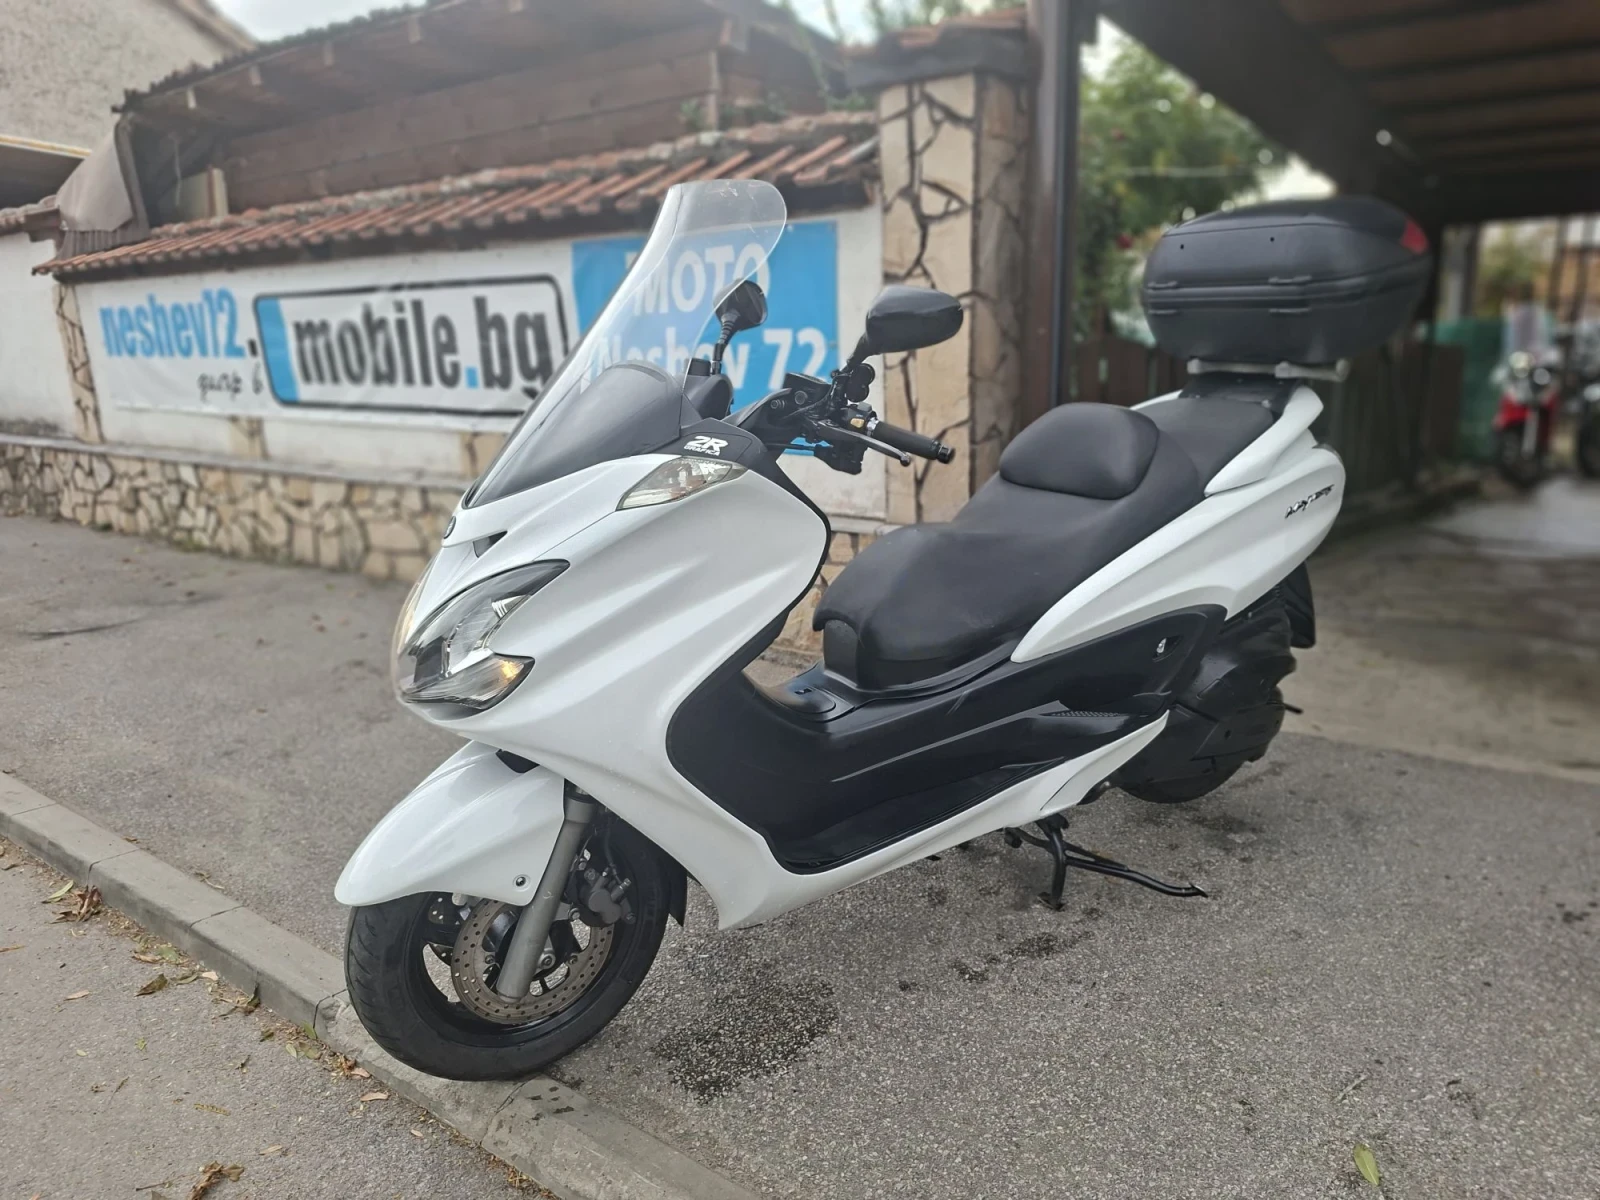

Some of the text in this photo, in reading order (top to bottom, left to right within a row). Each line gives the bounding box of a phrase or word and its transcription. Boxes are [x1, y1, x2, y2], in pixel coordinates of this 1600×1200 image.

[625, 243, 770, 316] MOTO
[293, 296, 553, 399] mobile.bg
[763, 328, 827, 390] 72
